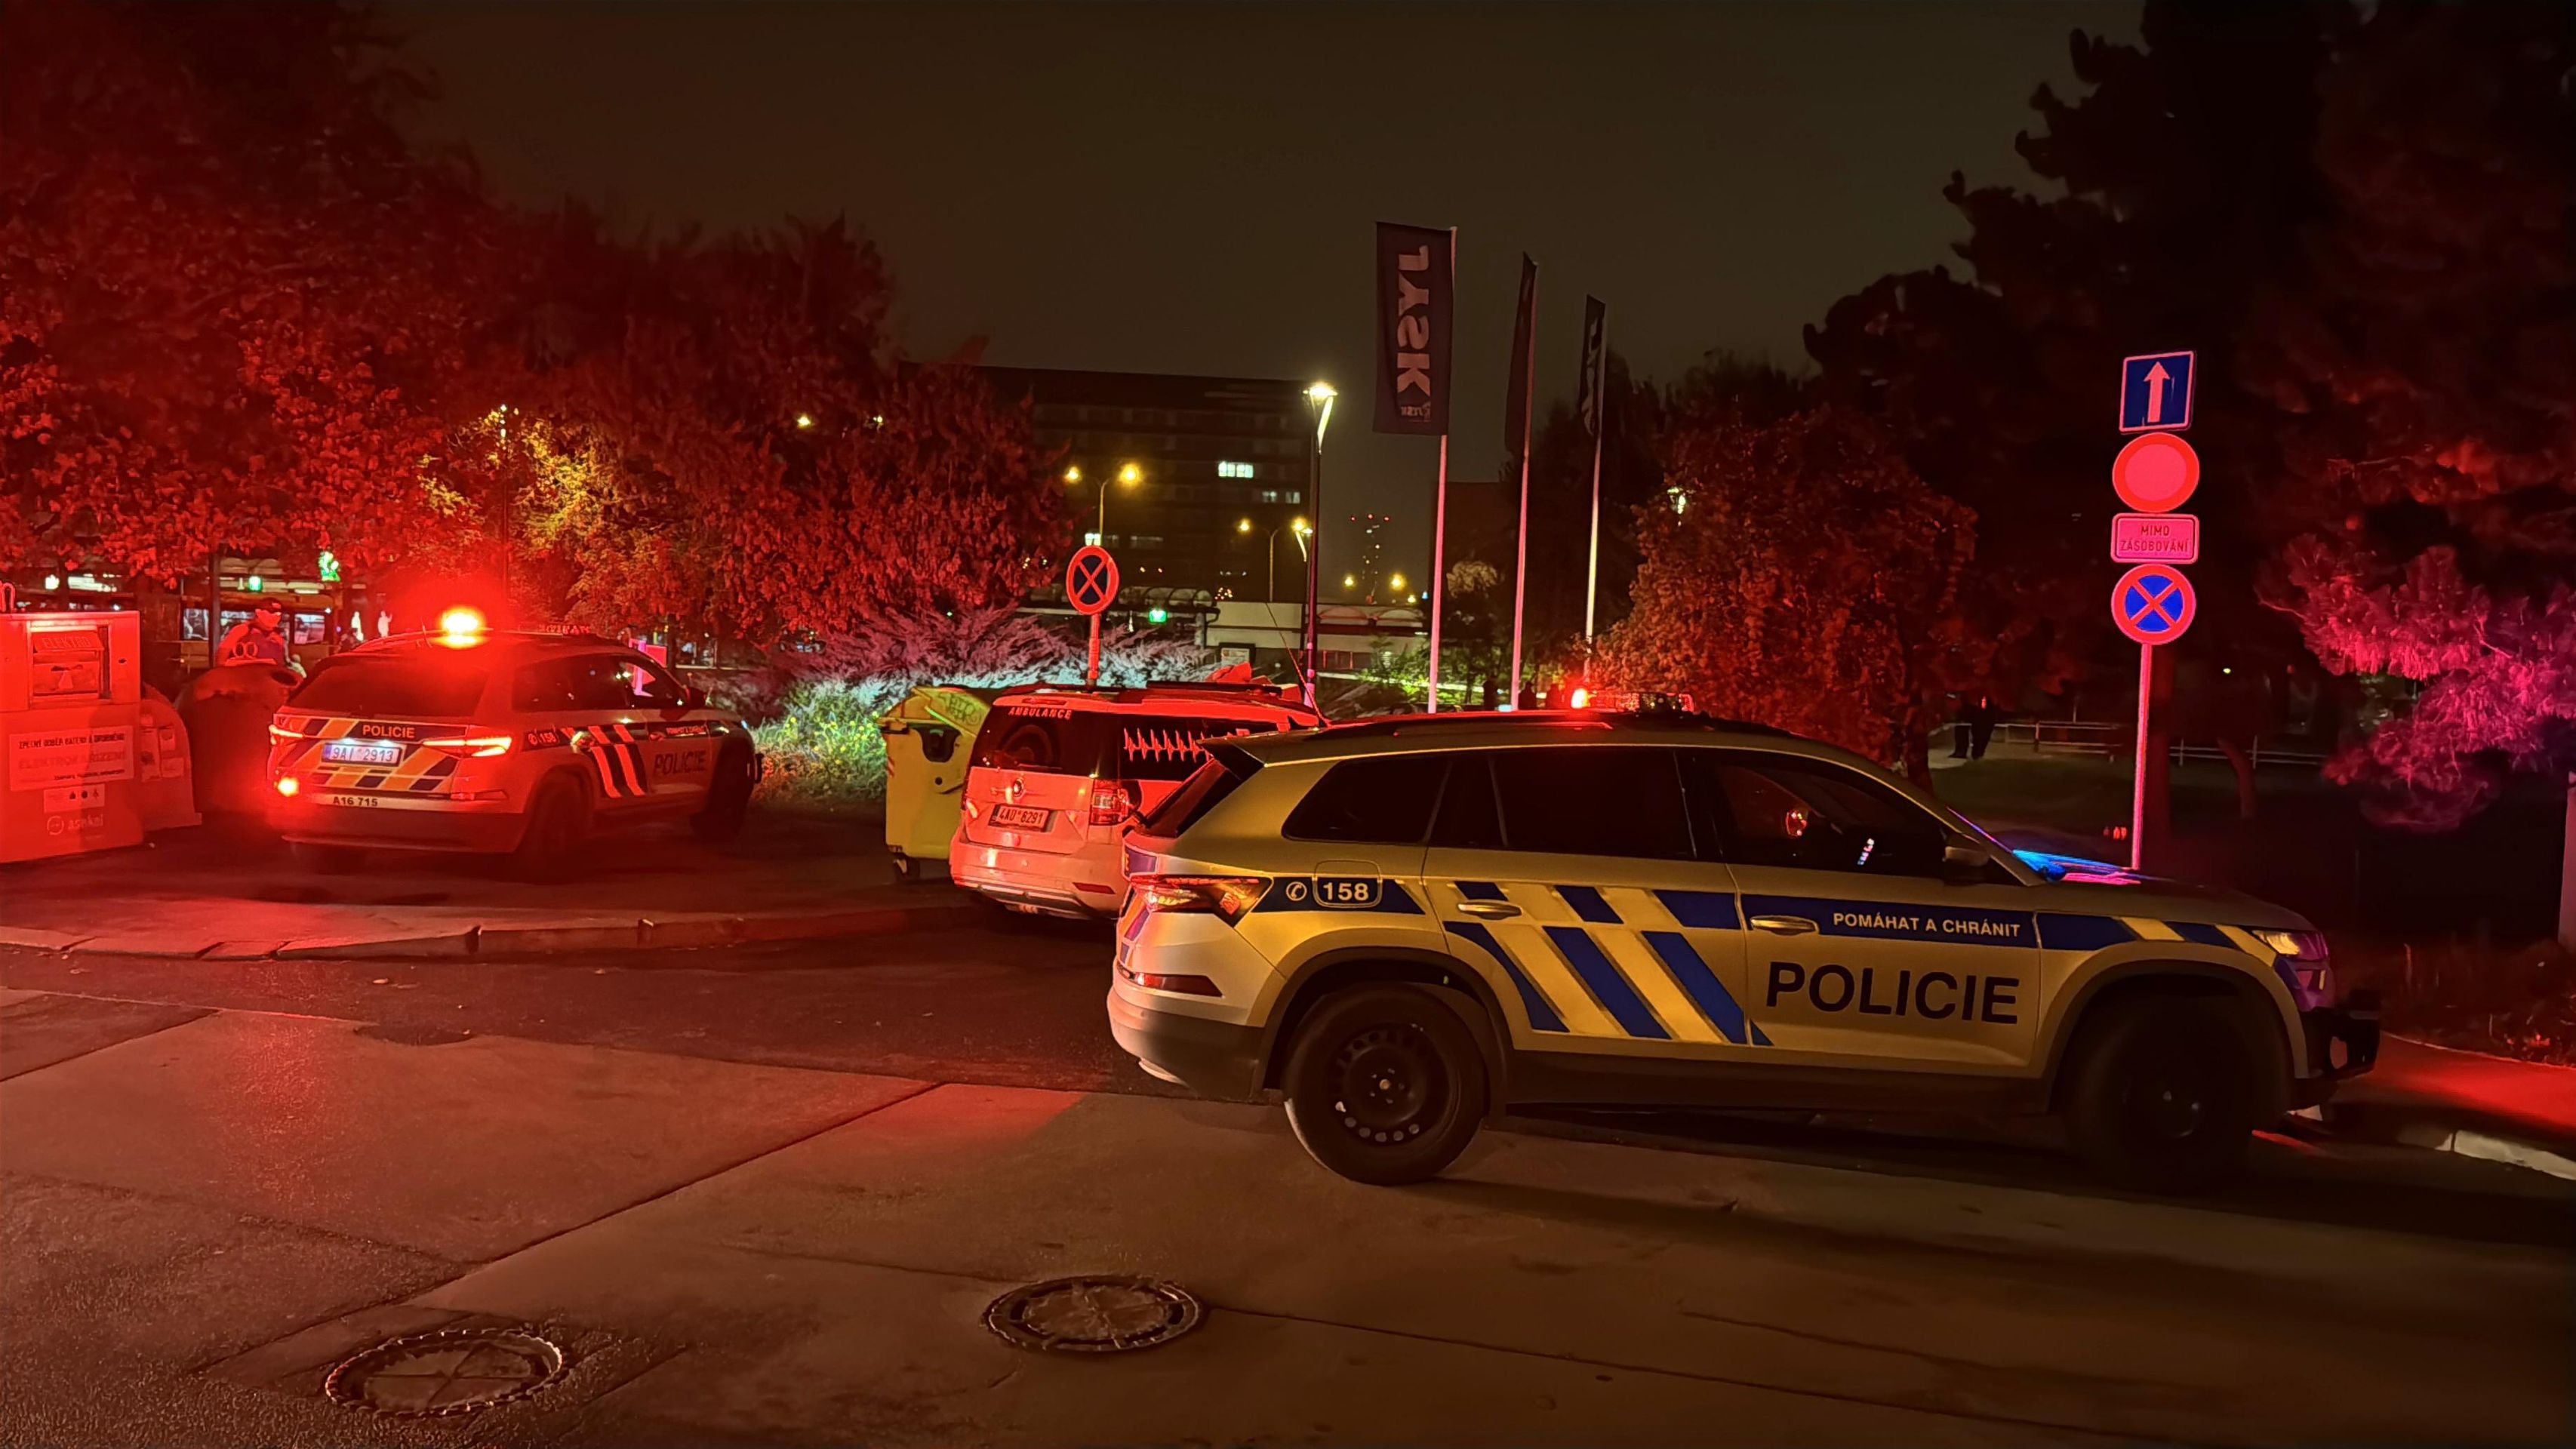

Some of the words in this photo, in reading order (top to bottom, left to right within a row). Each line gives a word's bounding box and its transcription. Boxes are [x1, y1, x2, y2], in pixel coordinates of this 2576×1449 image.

[2141, 525, 2170, 537] MIMO
[2119, 537, 2189, 552] ZÁSOBOVÁNÍ
[1008, 706, 1073, 720] AMBULANCE
[362, 724, 415, 739] POLICIE
[363, 749, 394, 762] 2913
[654, 750, 706, 776] POLICIE
[333, 796, 354, 805] A16
[358, 798, 377, 807] 715
[1323, 881, 1369, 901] 158
[1833, 912, 1919, 932] POMÁHAT
[1925, 919, 1937, 933] A
[1942, 918, 2021, 937] CHRÁNIT
[1766, 961, 2020, 1025] POLICIE
